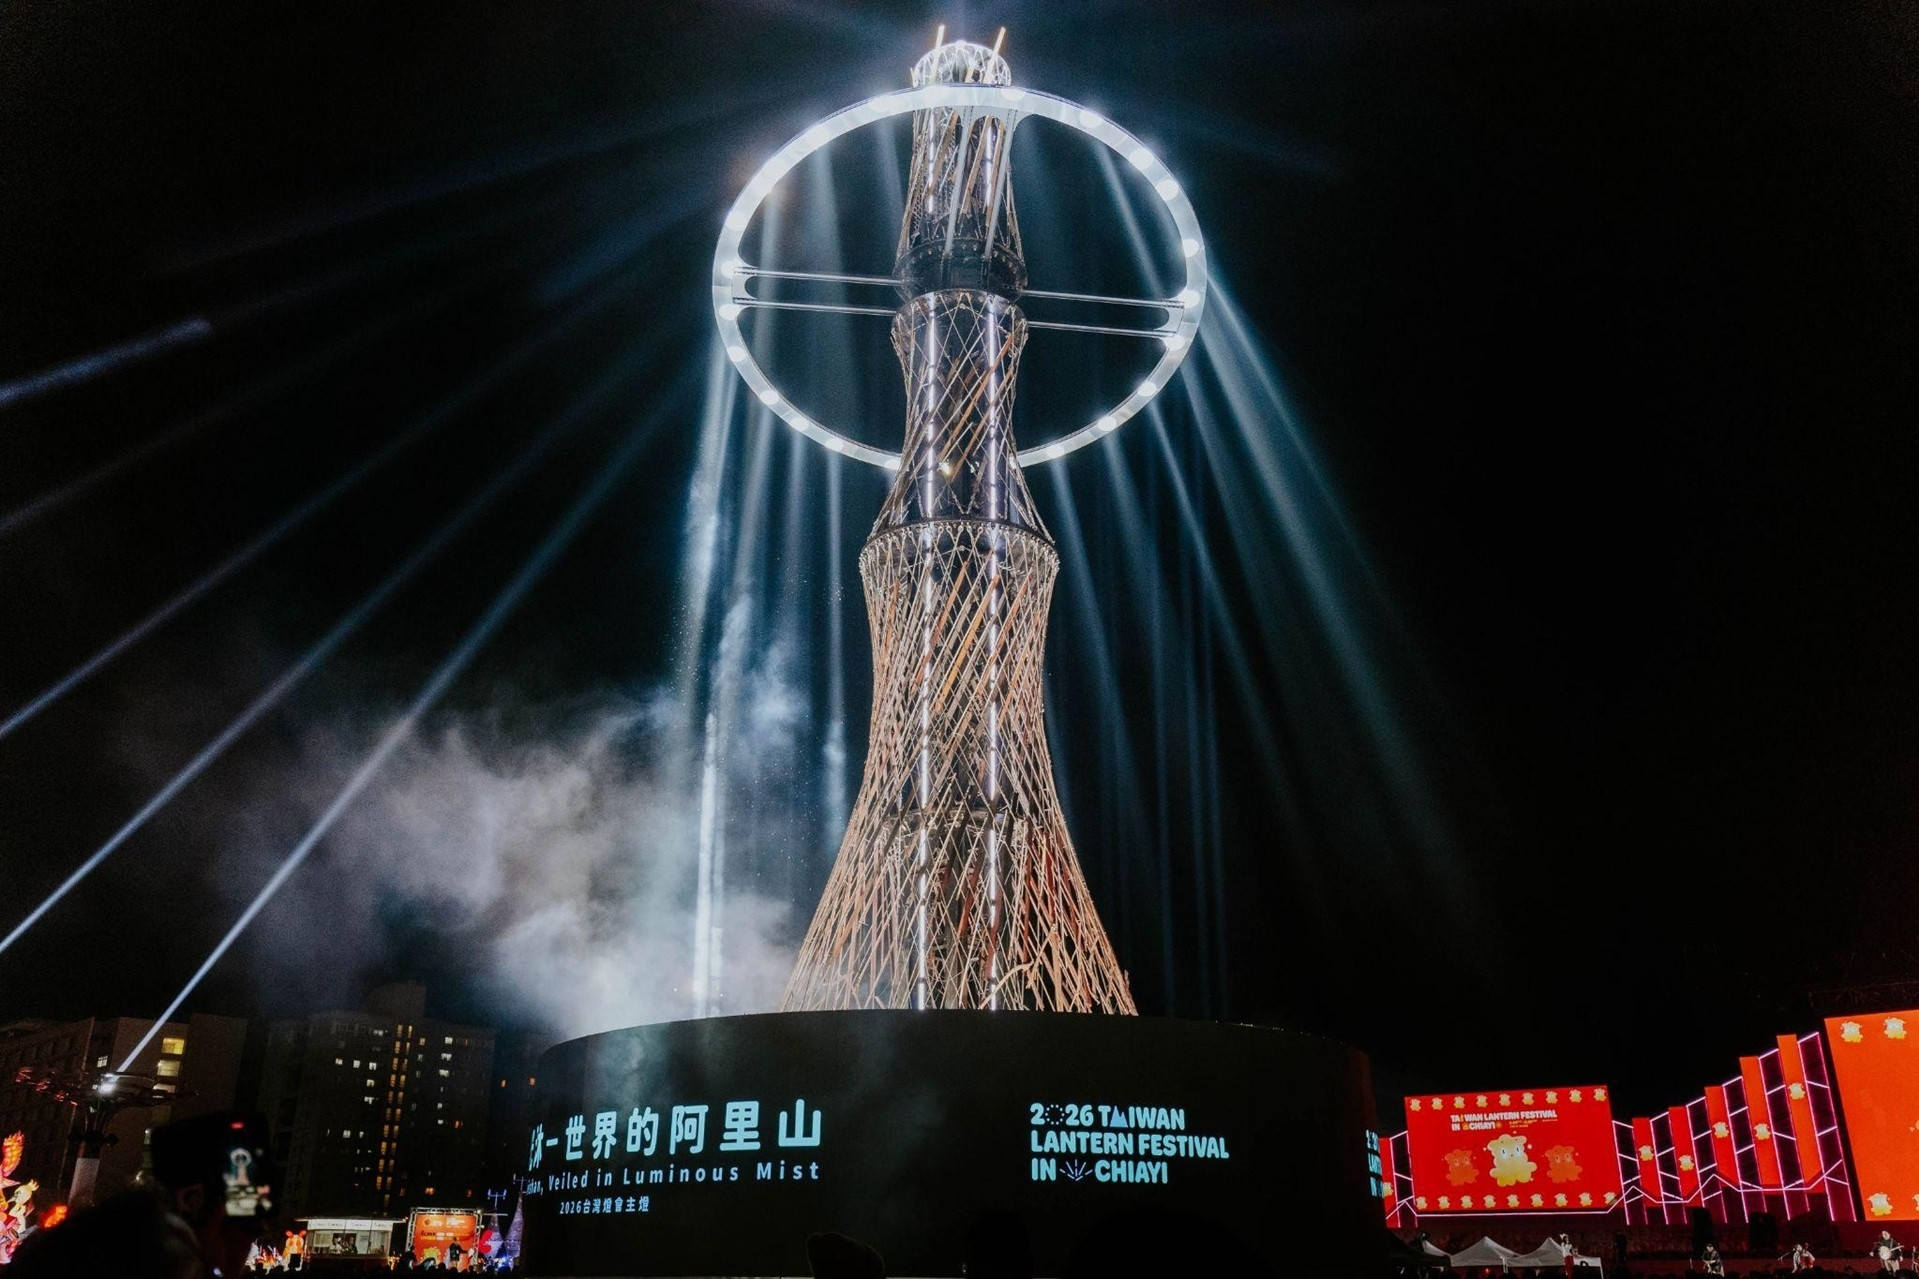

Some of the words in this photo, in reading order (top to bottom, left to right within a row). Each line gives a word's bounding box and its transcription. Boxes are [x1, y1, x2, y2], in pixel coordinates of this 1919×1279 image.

[1030, 1102, 1094, 1126] 2026
[1097, 1104, 1185, 1130] TAIWAN
[1451, 1123, 1461, 1131] IN
[1484, 1111, 1520, 1121] LANTERN
[1520, 1109, 1558, 1119] FESTIVAL
[1030, 1130, 1133, 1155] LANTERN
[1137, 1134, 1230, 1159] FESTIVAL
[549, 1170, 589, 1191] Veiled
[596, 1168, 612, 1187] in
[623, 1163, 739, 1185] Luminous
[756, 1159, 819, 1181] Mist
[1030, 1158, 1057, 1182] IN
[1094, 1160, 1168, 1184] CHIAYI
